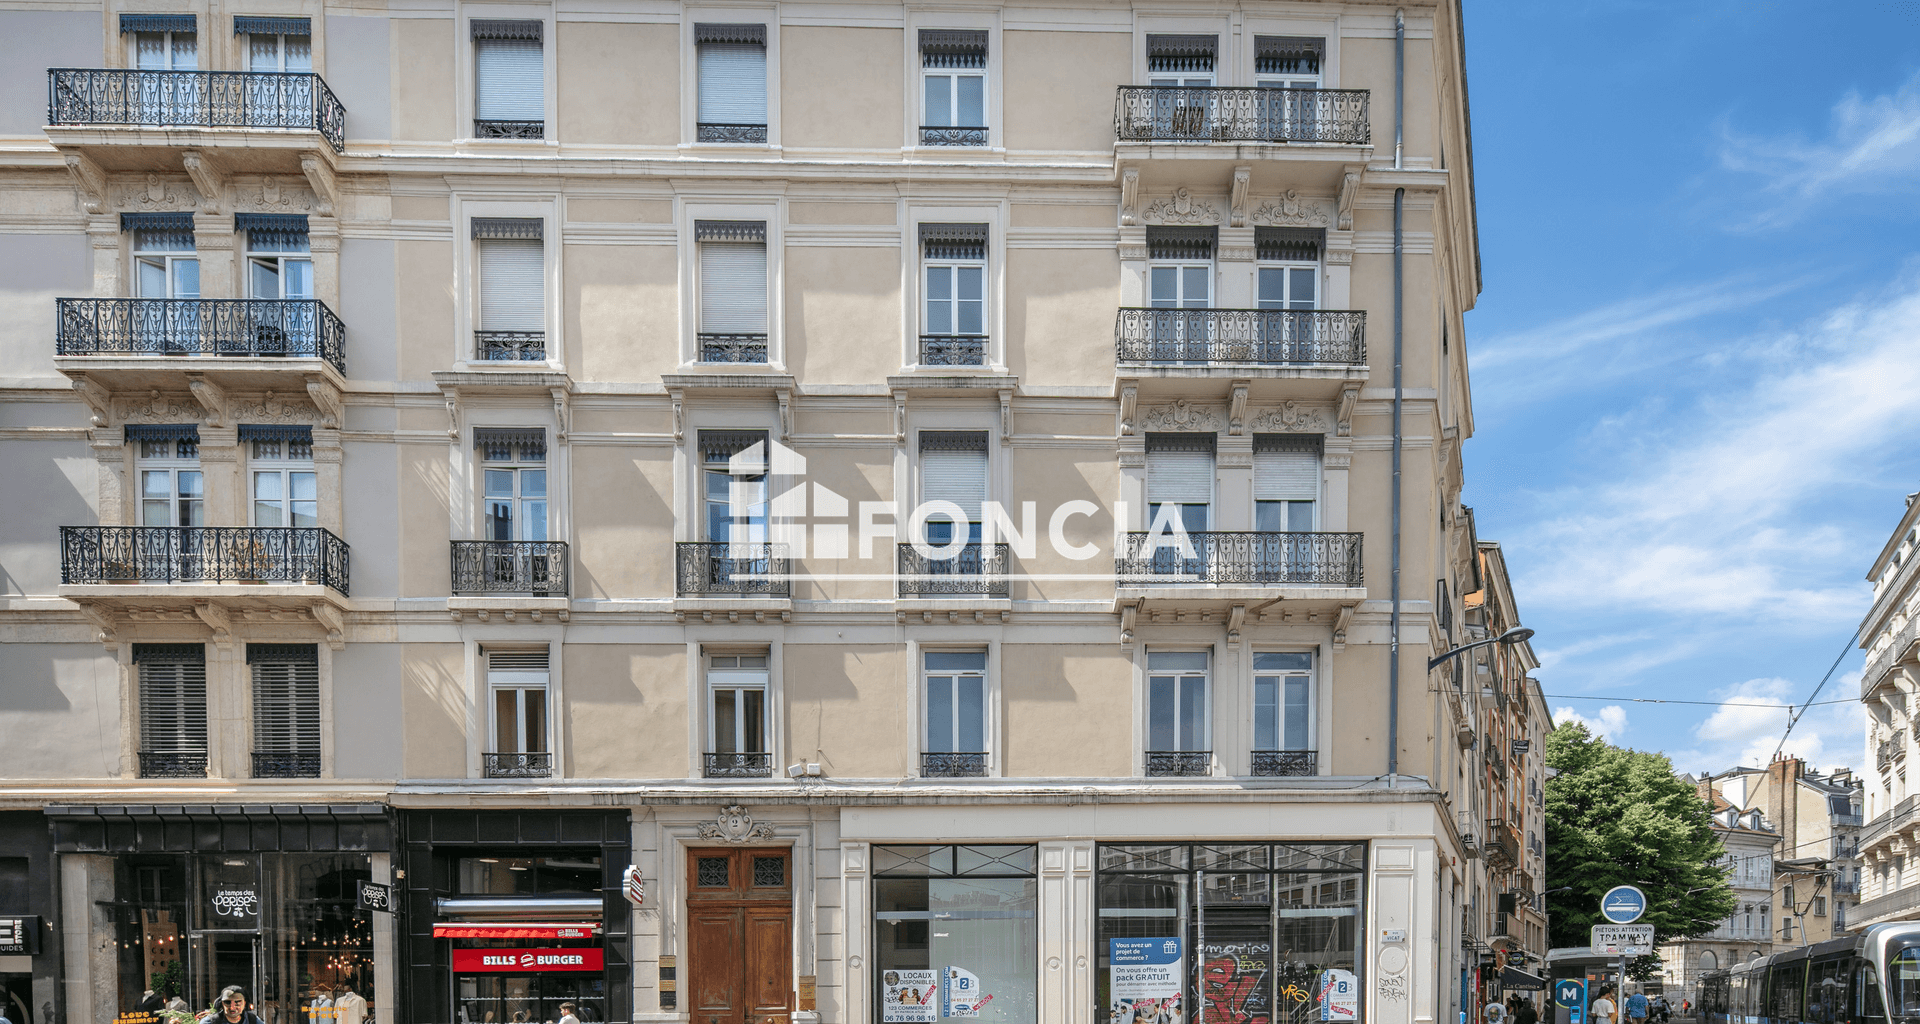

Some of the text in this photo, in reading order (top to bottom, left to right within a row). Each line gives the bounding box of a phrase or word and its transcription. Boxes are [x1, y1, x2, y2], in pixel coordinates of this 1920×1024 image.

[225, 890, 242, 898] temps
[14, 920, 23, 944] STORE
[1600, 933, 1647, 942] TRAMWAY
[483, 955, 583, 965] BILLS BURGER
[1116, 974, 1134, 982] pack
[1562, 987, 1577, 1001] M
